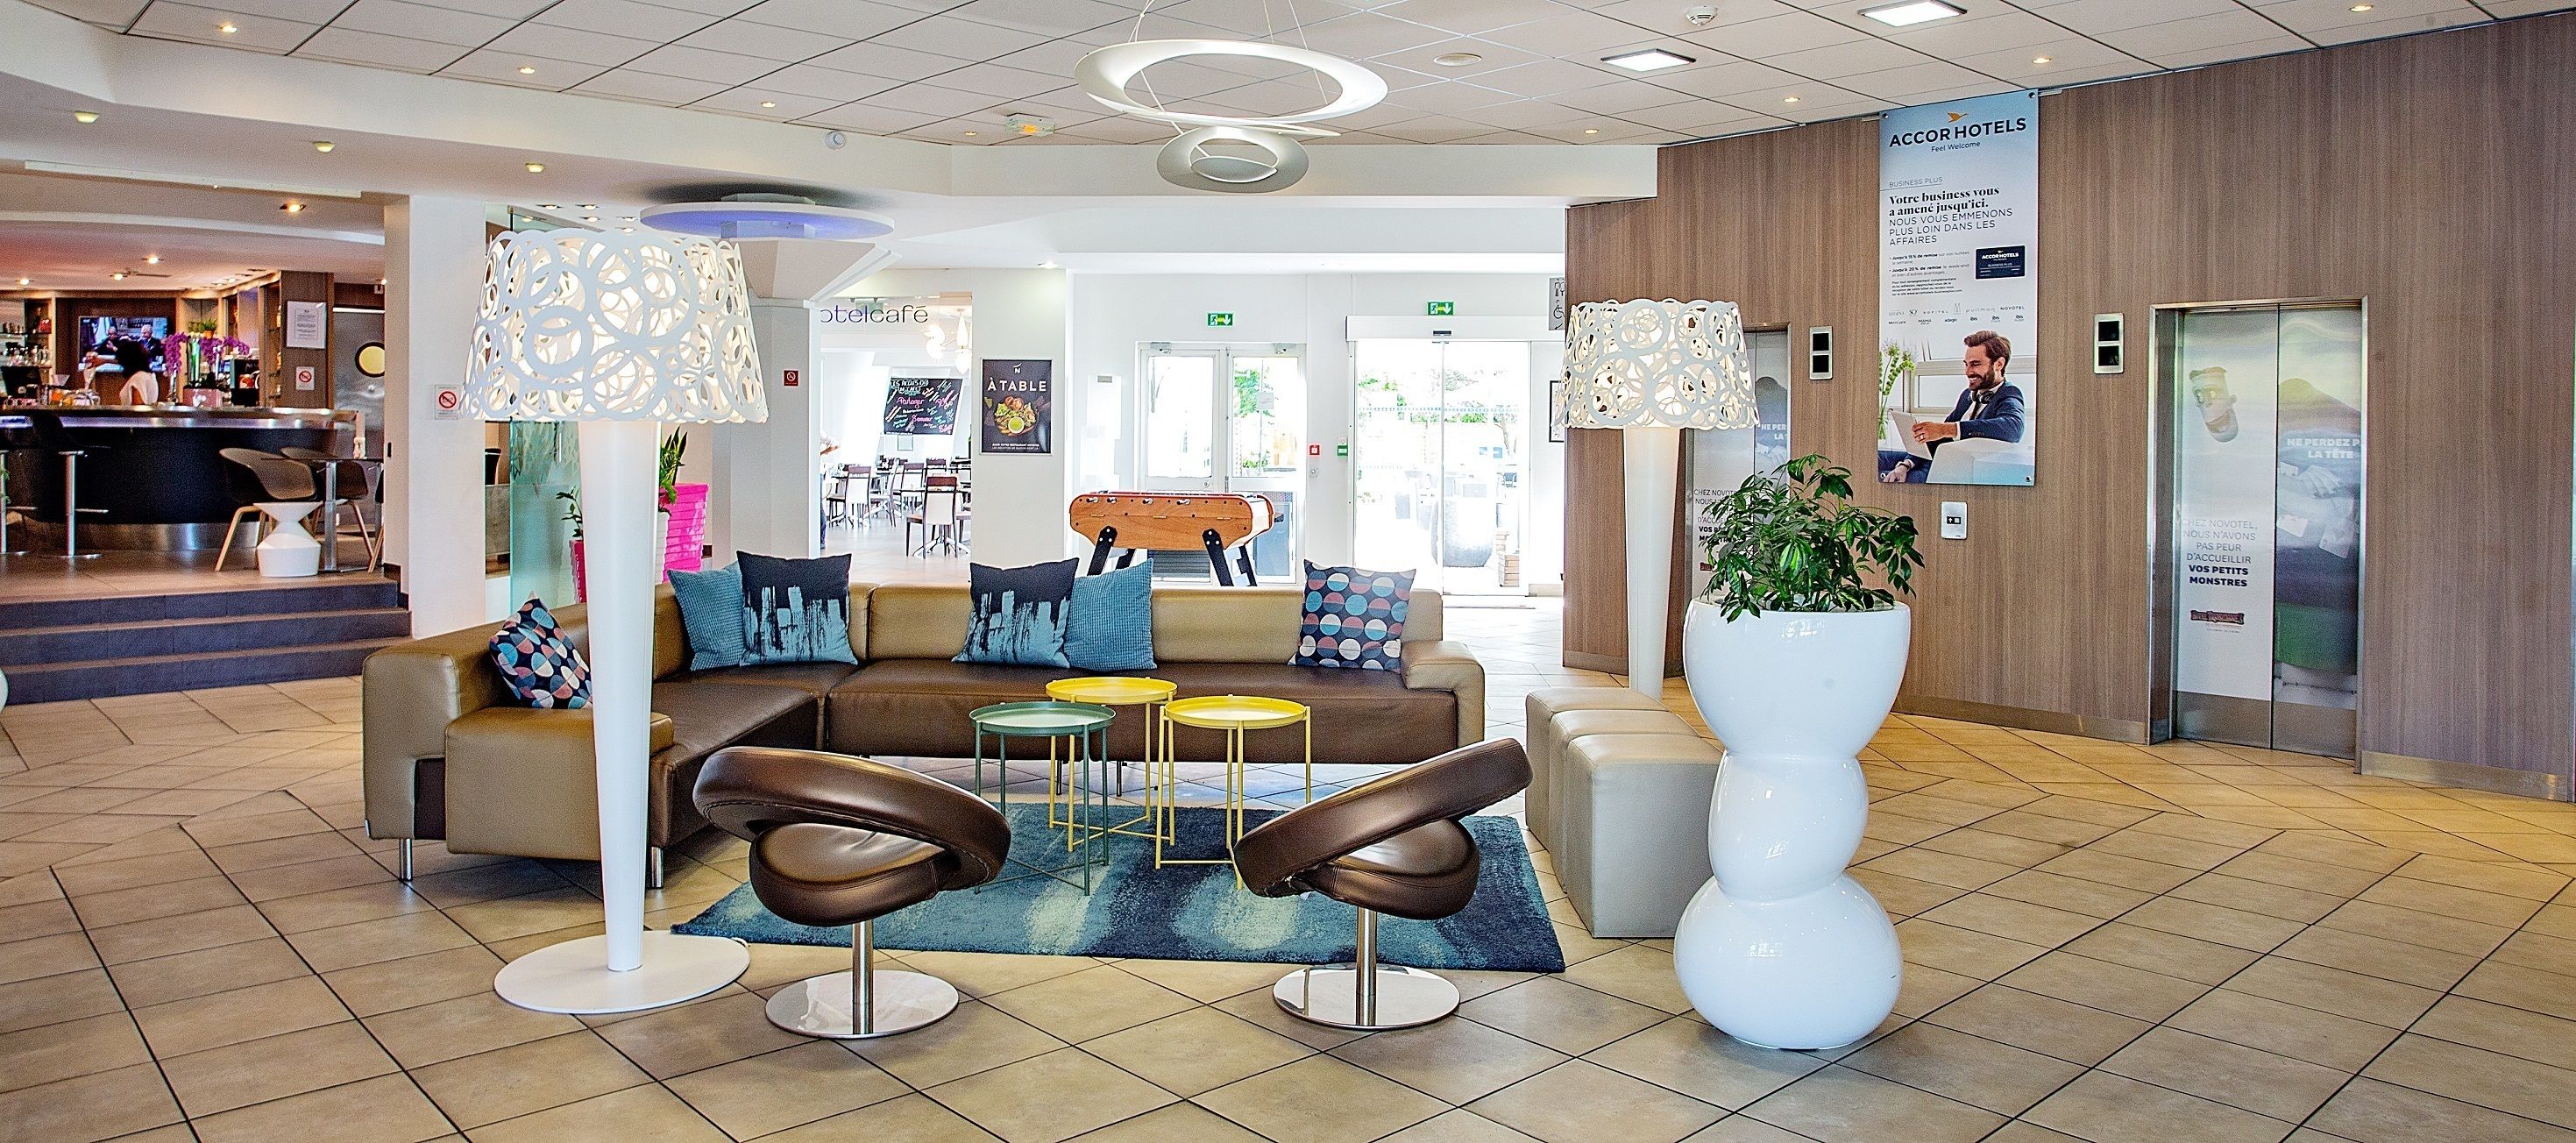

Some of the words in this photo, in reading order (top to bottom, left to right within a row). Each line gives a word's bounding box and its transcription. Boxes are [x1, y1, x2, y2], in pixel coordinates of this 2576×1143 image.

[1948, 140, 1981, 150] Welcome
[1889, 179, 1923, 188] BUSINESS
[1889, 194, 1920, 204] Votre
[1922, 190, 1971, 202] business
[1973, 187, 1999, 196] vous
[1898, 204, 1934, 215] amené
[1935, 198, 1989, 214] jusqu'ici.
[1889, 217, 1917, 226] NOUS
[1920, 214, 1948, 224] VOUS
[1952, 208, 2013, 222] EMMENONS
[1889, 226, 1913, 237] PLUS
[1917, 224, 1941, 234] LOIN
[1944, 223, 1972, 232] DANS
[1976, 220, 1996, 229] LES
[1889, 235, 1937, 245] AFFAIRES
[987, 377, 997, 391] À
[999, 380, 1047, 392] TABLE
[2304, 438, 2350, 447] PERDEZ
[2324, 449, 2354, 458] TÊTE
[2181, 519, 2207, 528] CHEZ
[2182, 530, 2211, 539] NOUS
[2213, 531, 2256, 540] N'AVONS
[2196, 542, 2214, 550] PAS
[2216, 543, 2242, 551] PEUR
[2186, 552, 2253, 564] D'ACCUEILLIR
[2189, 564, 2211, 573] VOS
[2211, 565, 2249, 576] PETITS
[2189, 576, 2248, 587] MONSTRES
